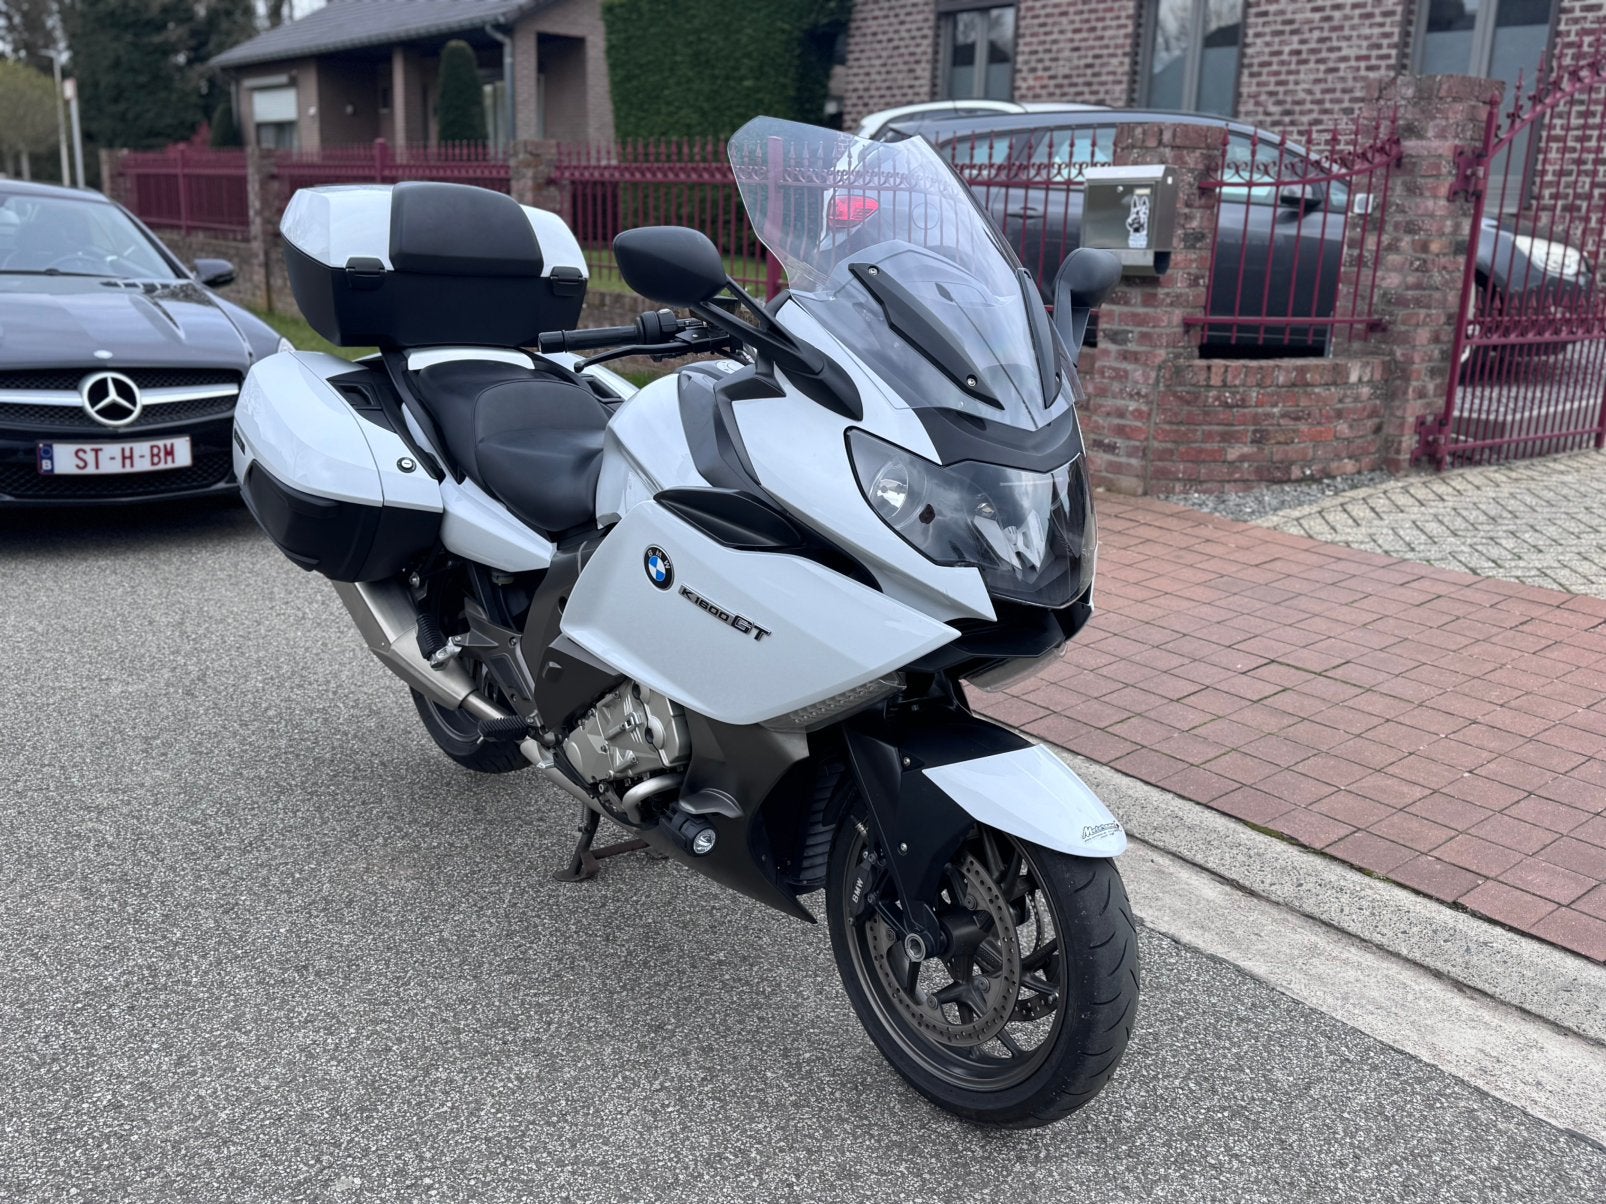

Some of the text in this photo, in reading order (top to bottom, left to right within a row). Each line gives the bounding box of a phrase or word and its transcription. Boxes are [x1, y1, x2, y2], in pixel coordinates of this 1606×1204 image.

[41, 459, 53, 471] B
[74, 442, 176, 471] ST-H-BM
[647, 549, 671, 569] BMW
[852, 877, 864, 903] BMW
